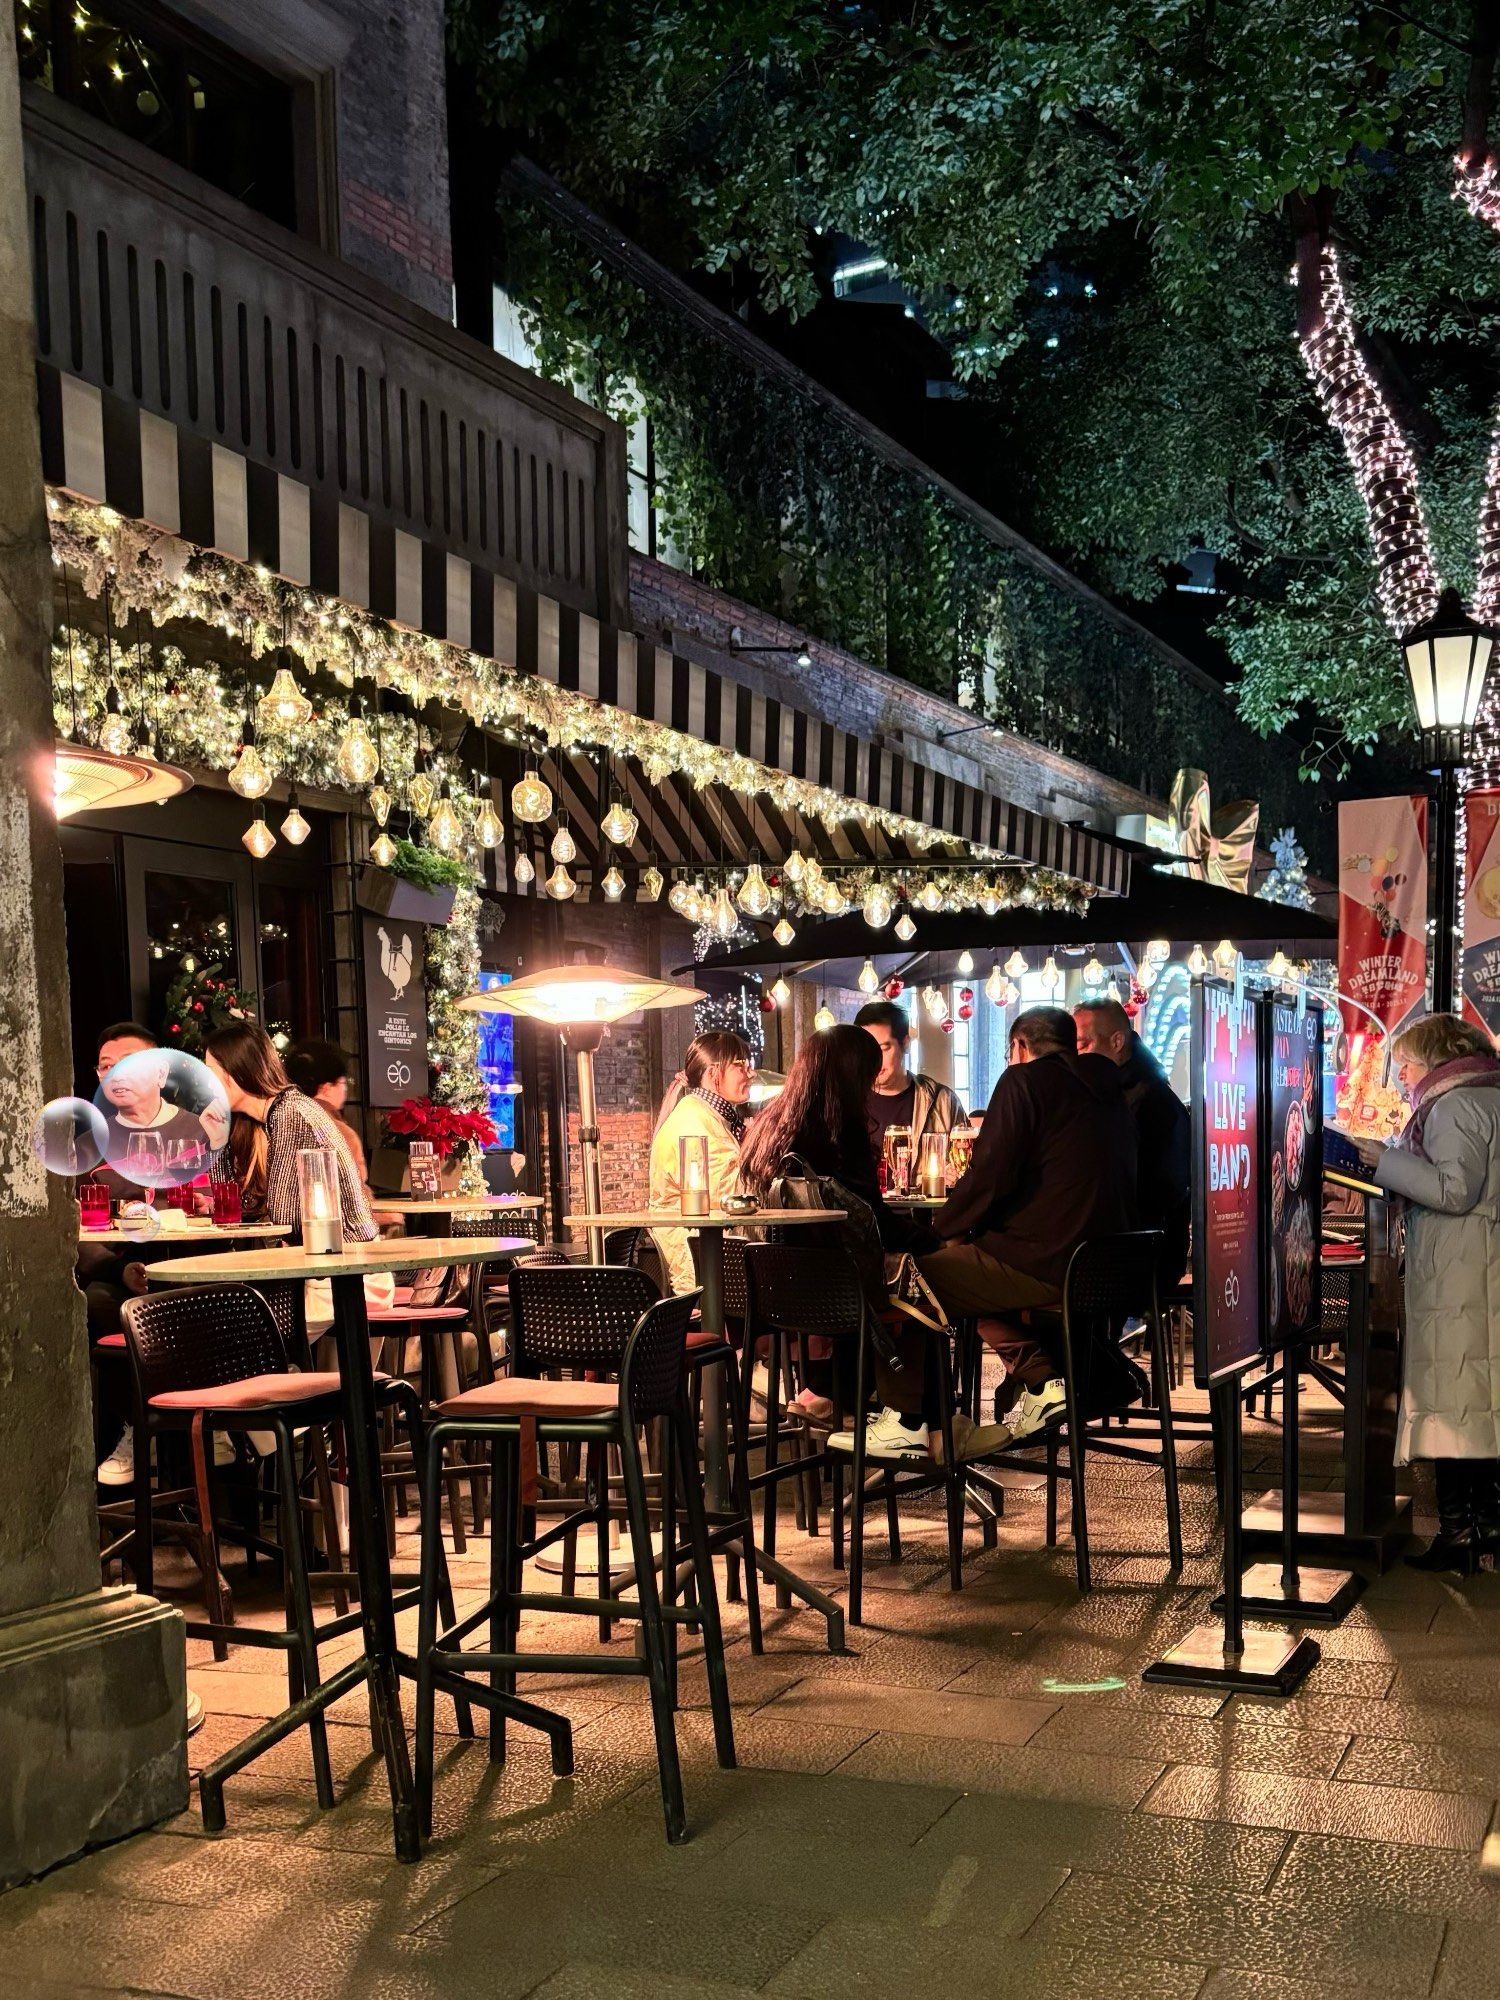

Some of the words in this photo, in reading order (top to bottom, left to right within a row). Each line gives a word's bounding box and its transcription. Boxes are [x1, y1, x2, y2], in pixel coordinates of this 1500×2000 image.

[1358, 955, 1402, 972] WINTER
[1348, 967, 1419, 990] DREAMLAND
[385, 1023, 402, 1031] POLLO
[378, 1030, 407, 1038] ENCANTAN
[384, 1036, 412, 1045] GINTONICS
[1214, 1080, 1246, 1131] LIVE
